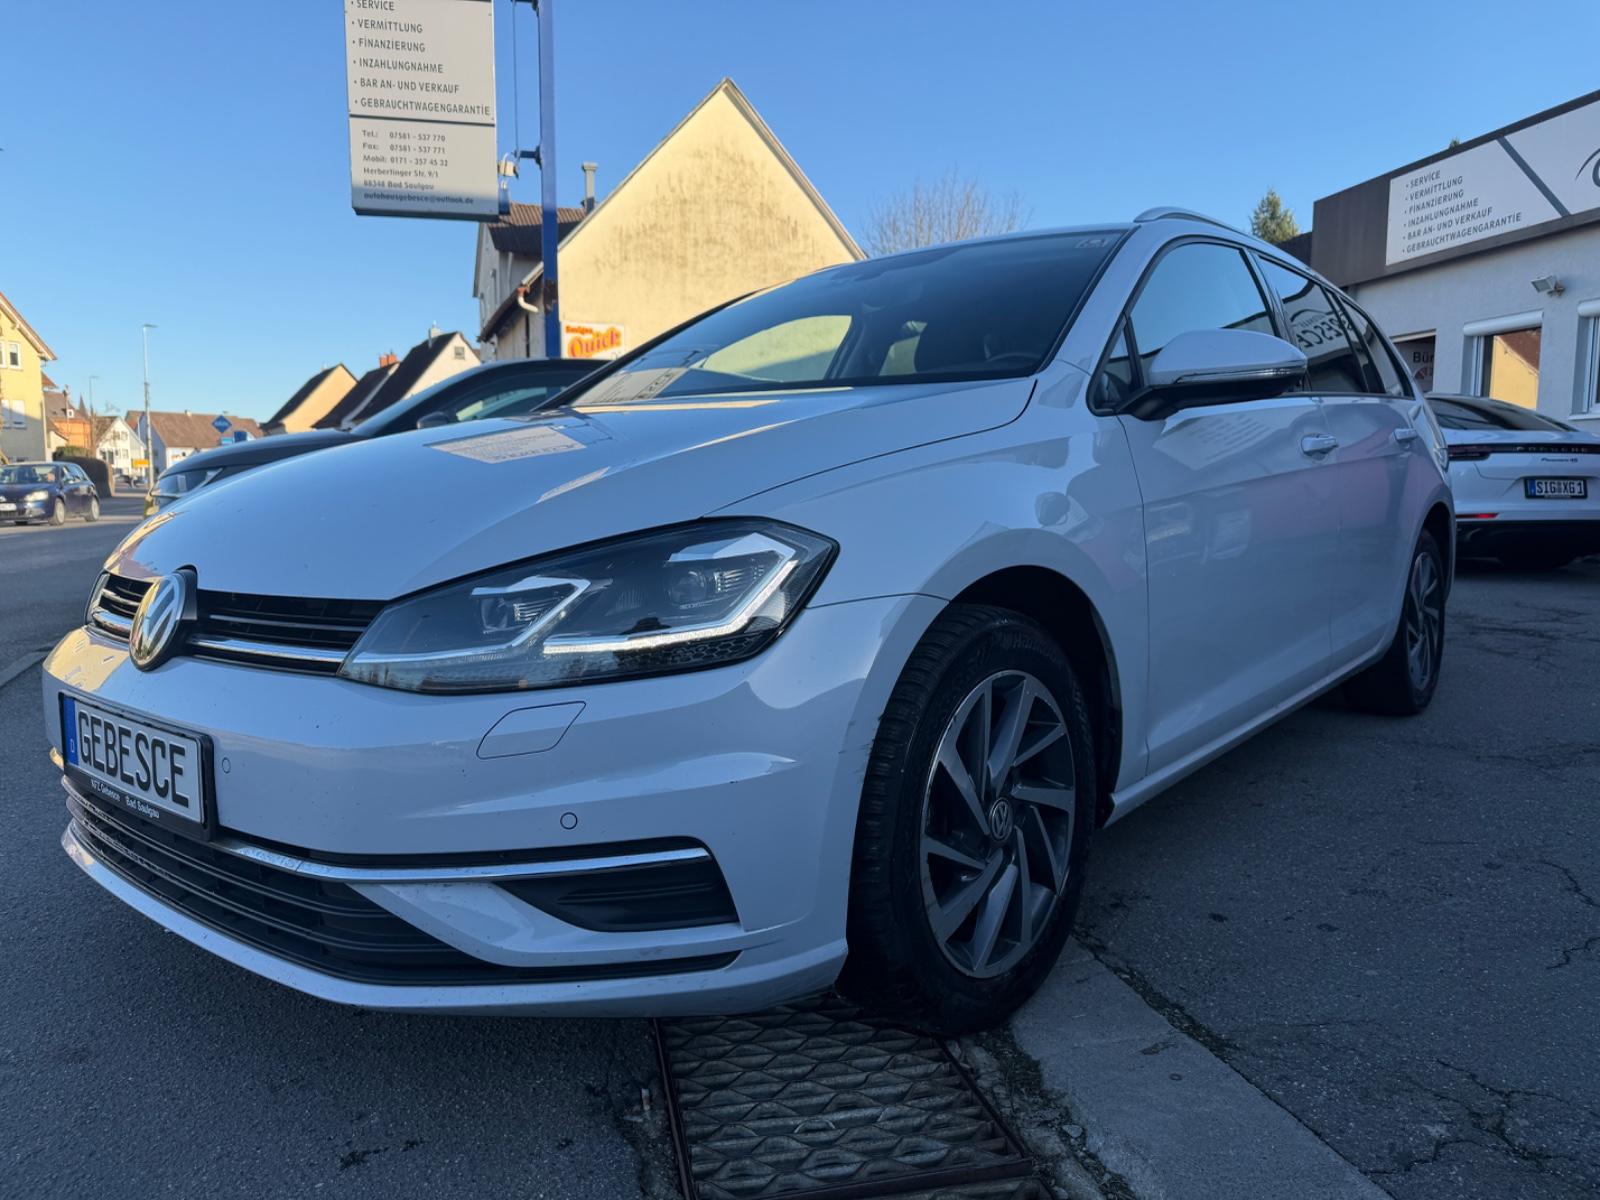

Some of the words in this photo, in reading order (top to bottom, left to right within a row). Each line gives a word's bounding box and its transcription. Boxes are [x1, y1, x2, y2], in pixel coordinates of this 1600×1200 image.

[360, 77, 378, 88] BAR
[397, 81, 417, 92] UND
[419, 83, 460, 94] VERKAUF
[1407, 228, 1422, 241] BAR
[1437, 219, 1453, 231] UND
[1455, 206, 1493, 227] VERKAUF
[1413, 351, 1434, 364] Bür
[1536, 481, 1556, 494] SIG
[78, 709, 190, 809] GEBESCE
